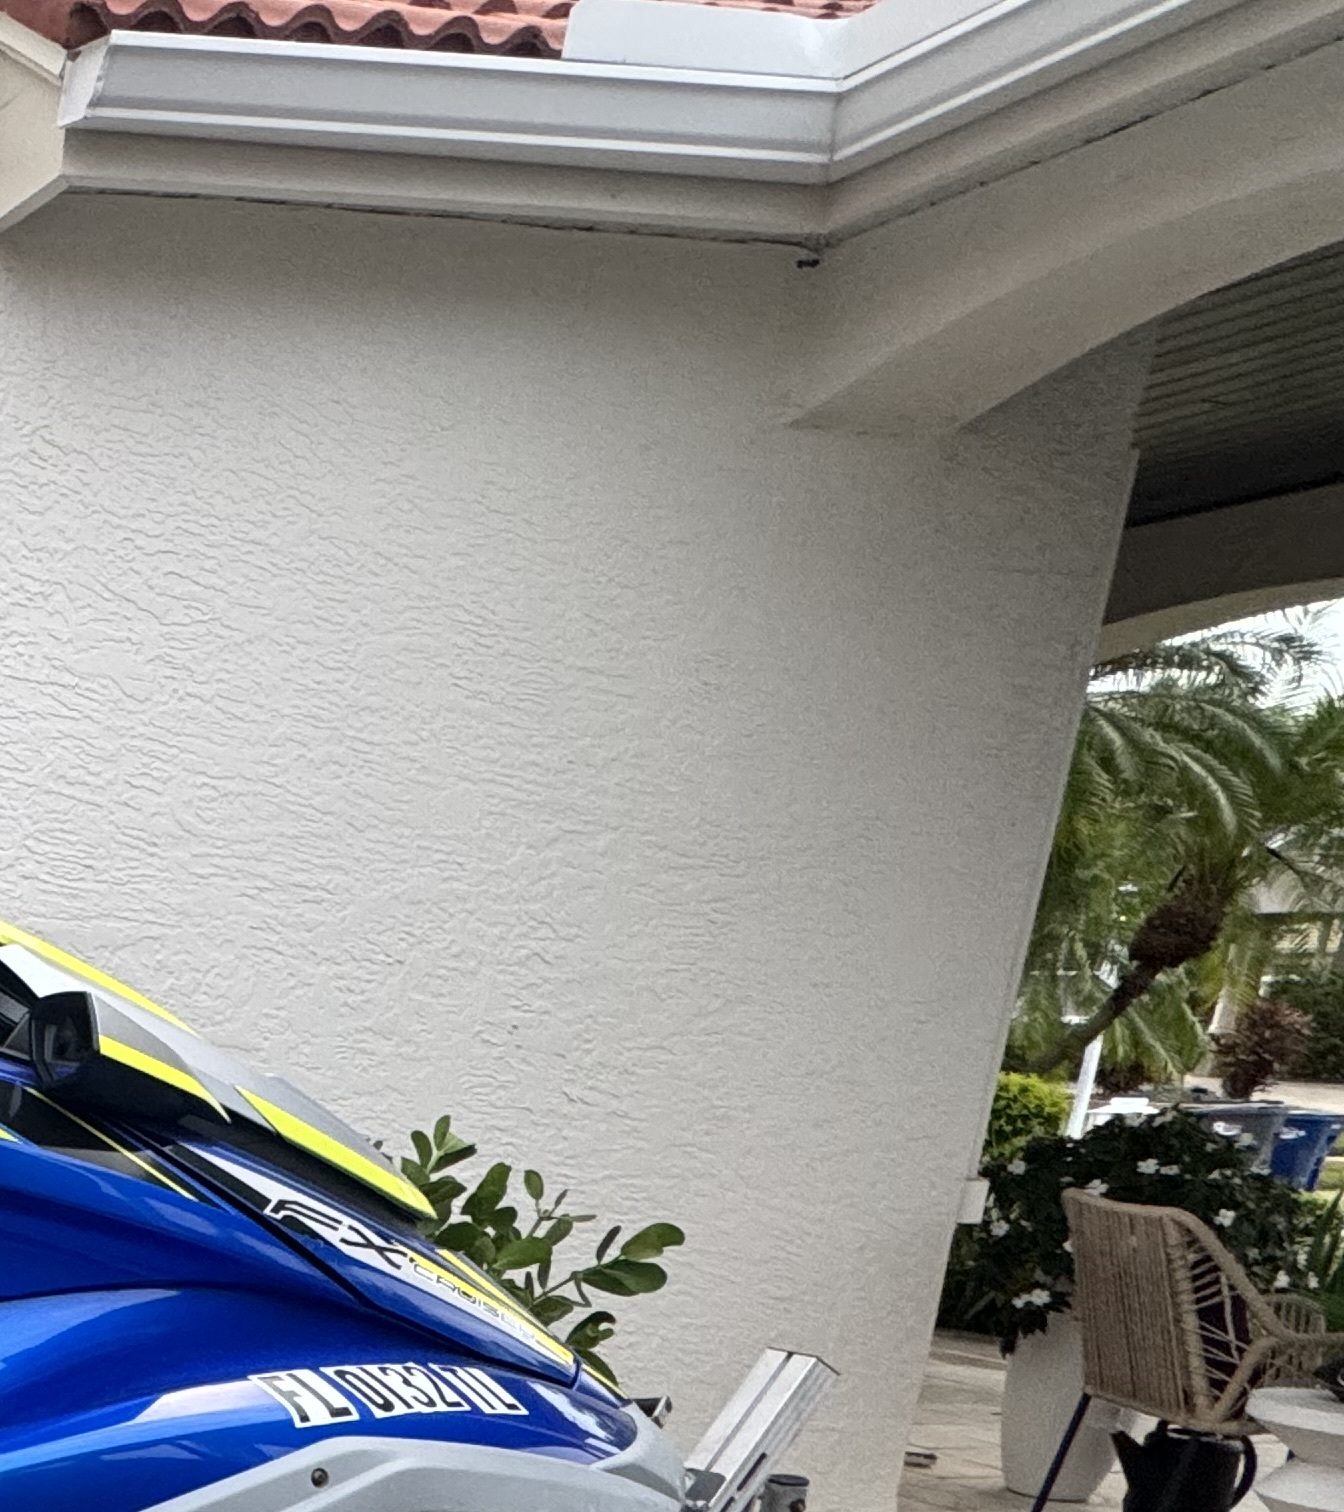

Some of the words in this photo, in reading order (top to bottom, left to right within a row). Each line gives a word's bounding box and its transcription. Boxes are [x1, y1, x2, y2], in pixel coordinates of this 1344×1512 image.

[270, 1199, 408, 1270] FX
[255, 1373, 354, 1423] FL
[437, 1366, 522, 1411] TL
